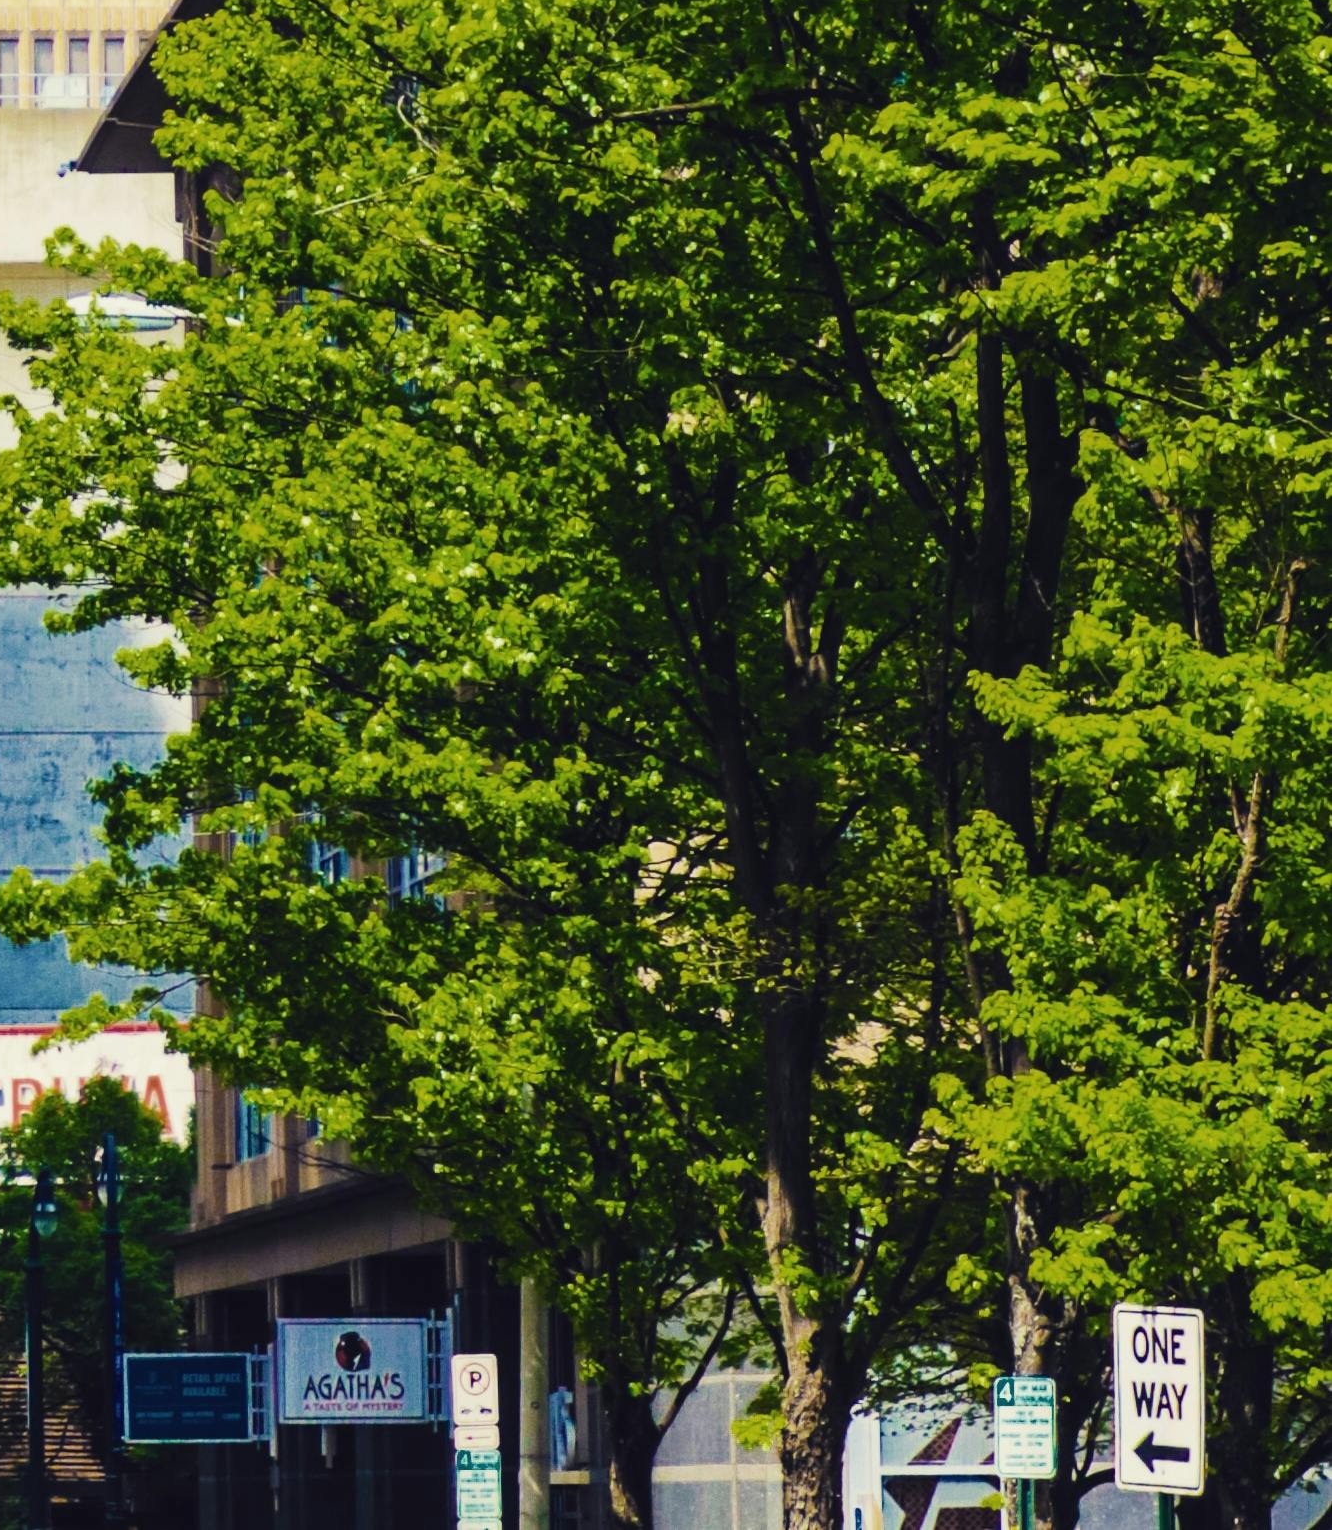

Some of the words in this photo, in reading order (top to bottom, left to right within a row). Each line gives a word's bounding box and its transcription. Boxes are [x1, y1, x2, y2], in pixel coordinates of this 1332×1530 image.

[1132, 1326, 1186, 1365] ONE
[303, 1372, 405, 1400] AGATHA'S
[999, 1382, 1012, 1402] 4
[304, 1403, 312, 1411] A
[314, 1403, 342, 1411] TASTE
[345, 1402, 359, 1411] OF
[362, 1402, 405, 1411] MYSTERY
[1132, 1381, 1188, 1420] WAY
